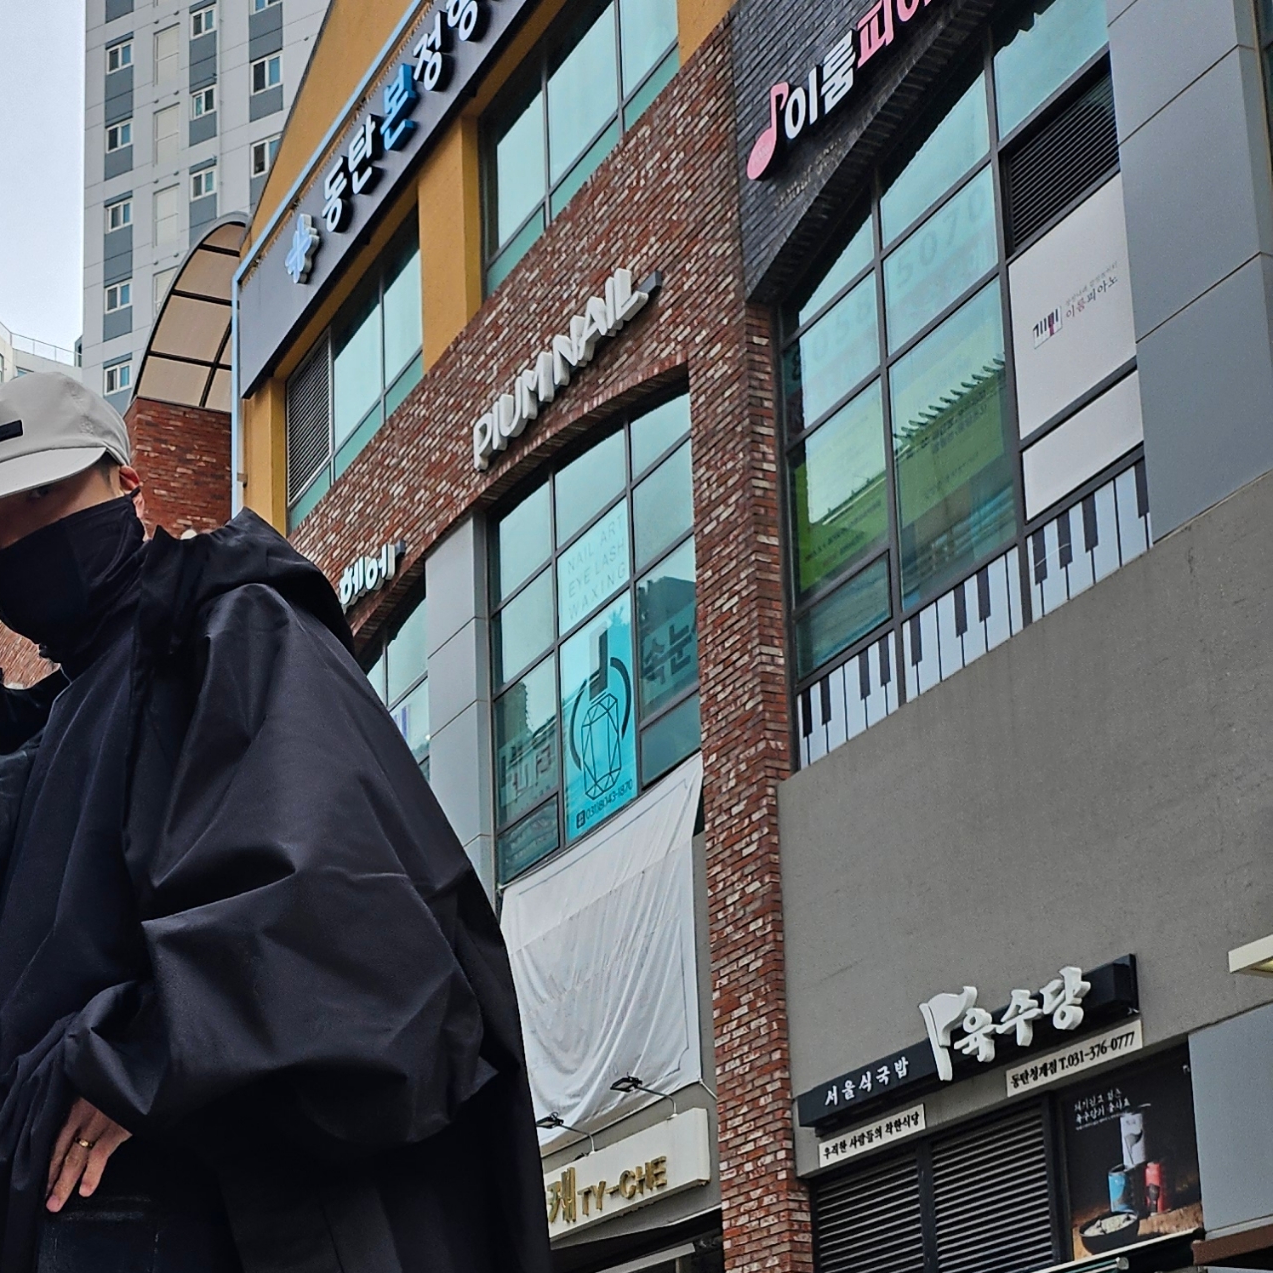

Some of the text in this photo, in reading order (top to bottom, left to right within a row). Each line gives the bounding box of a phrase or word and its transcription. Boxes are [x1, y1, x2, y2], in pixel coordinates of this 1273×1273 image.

[567, 513, 623, 574] NAIL ART
[568, 561, 626, 620] WAXING
[824, 966, 1091, 1106] 서울식국밥 육수당
[1058, 1031, 1135, 1072] T.031-376-0777
[823, 1111, 920, 1160] 우직한 사람들의 착한식당
